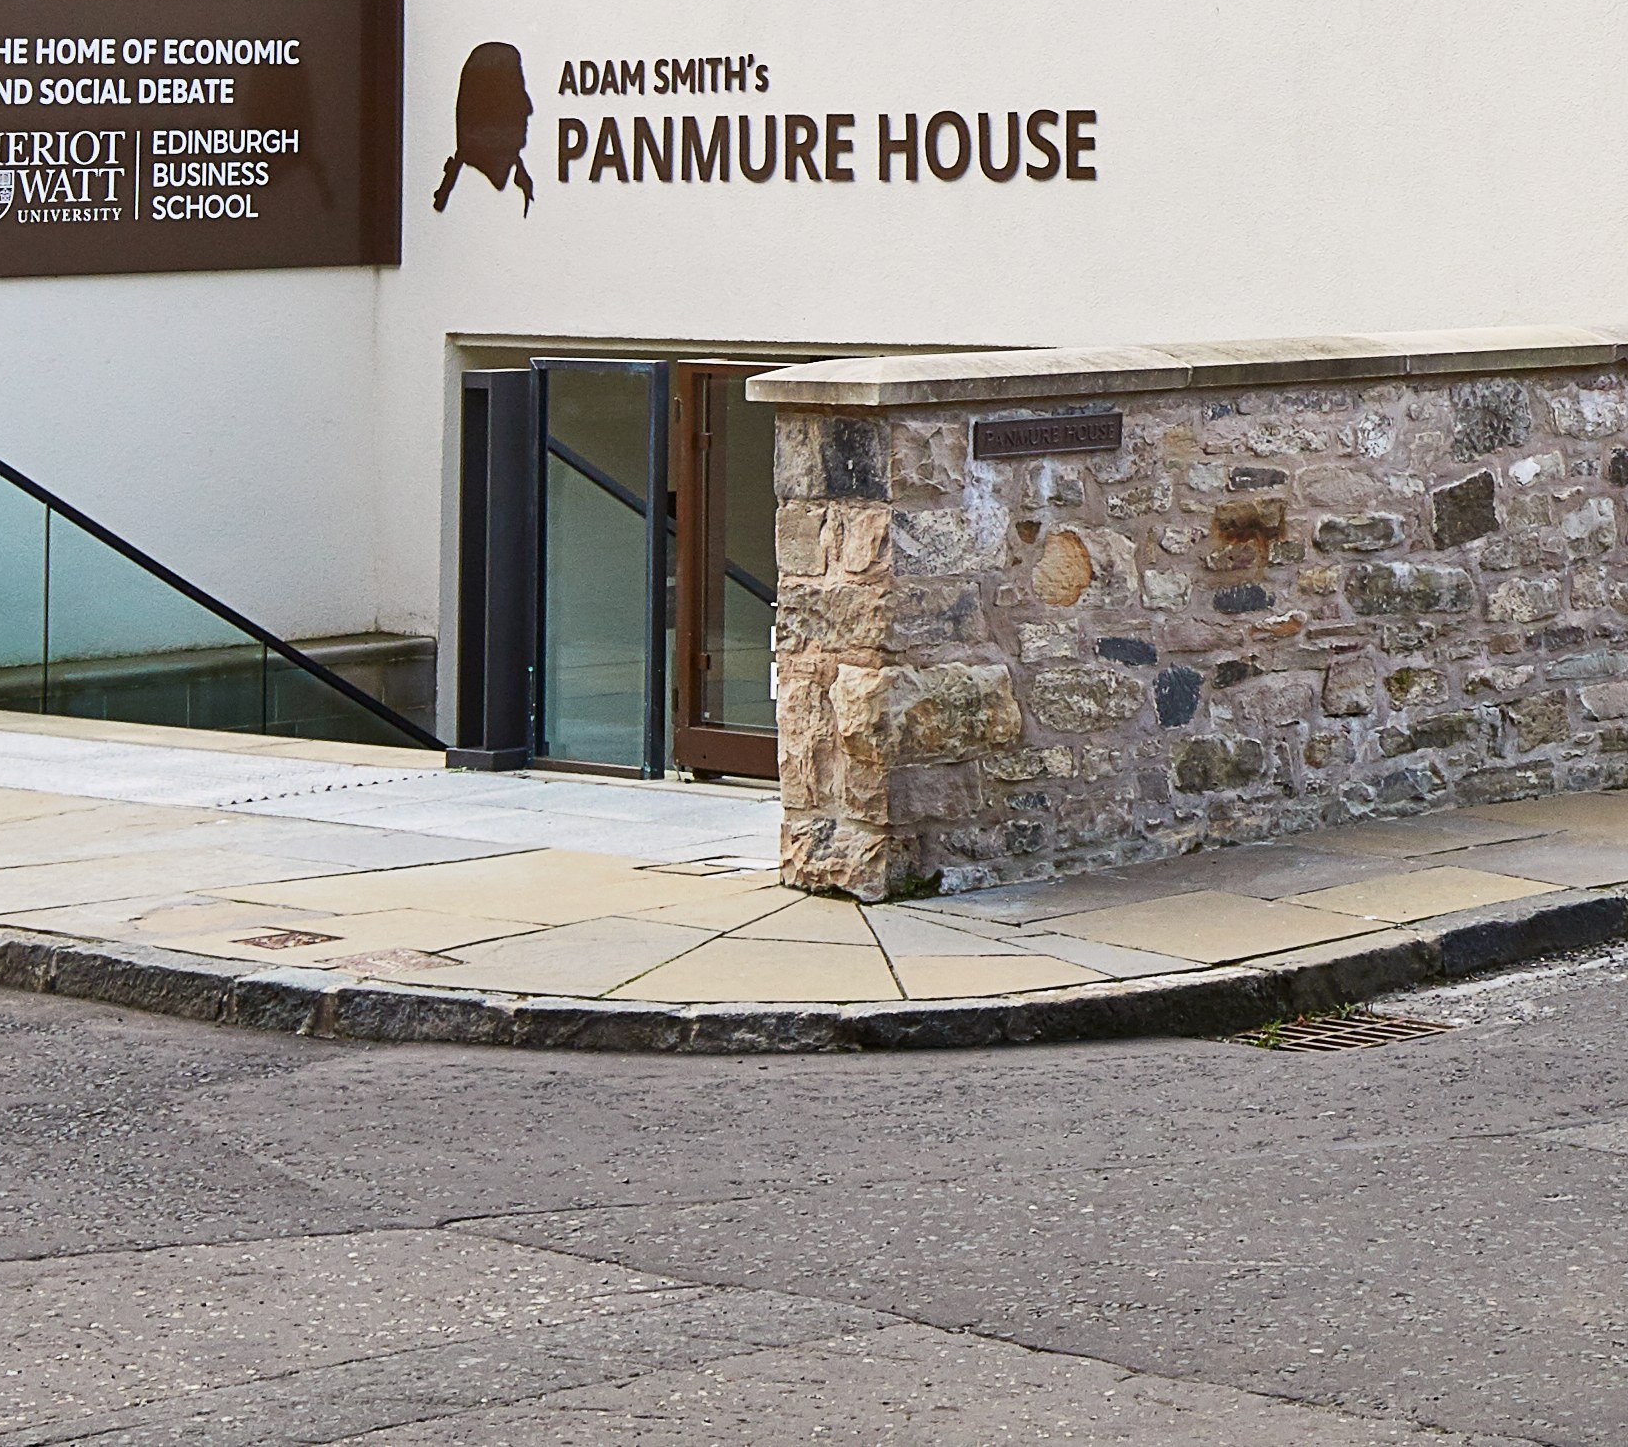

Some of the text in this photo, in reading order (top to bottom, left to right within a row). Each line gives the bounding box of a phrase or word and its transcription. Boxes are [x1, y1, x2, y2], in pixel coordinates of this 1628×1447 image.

[35, 38, 116, 65] HOME
[122, 38, 158, 65] OF
[163, 38, 300, 65] ECONOMIC
[557, 53, 770, 97] ADAM SMITH's
[39, 78, 132, 105] SOCIAL
[138, 78, 235, 104] DEBATE
[152, 129, 299, 155] EDINBURGH
[558, 109, 1097, 184] PANMURE HOUSE
[17, 167, 125, 204] WATT
[153, 161, 269, 188] BUSINESS
[17, 207, 122, 224] UNIVERSITY
[152, 193, 259, 220] SCHOOL
[985, 421, 1115, 448] PANMURE HOUSE
